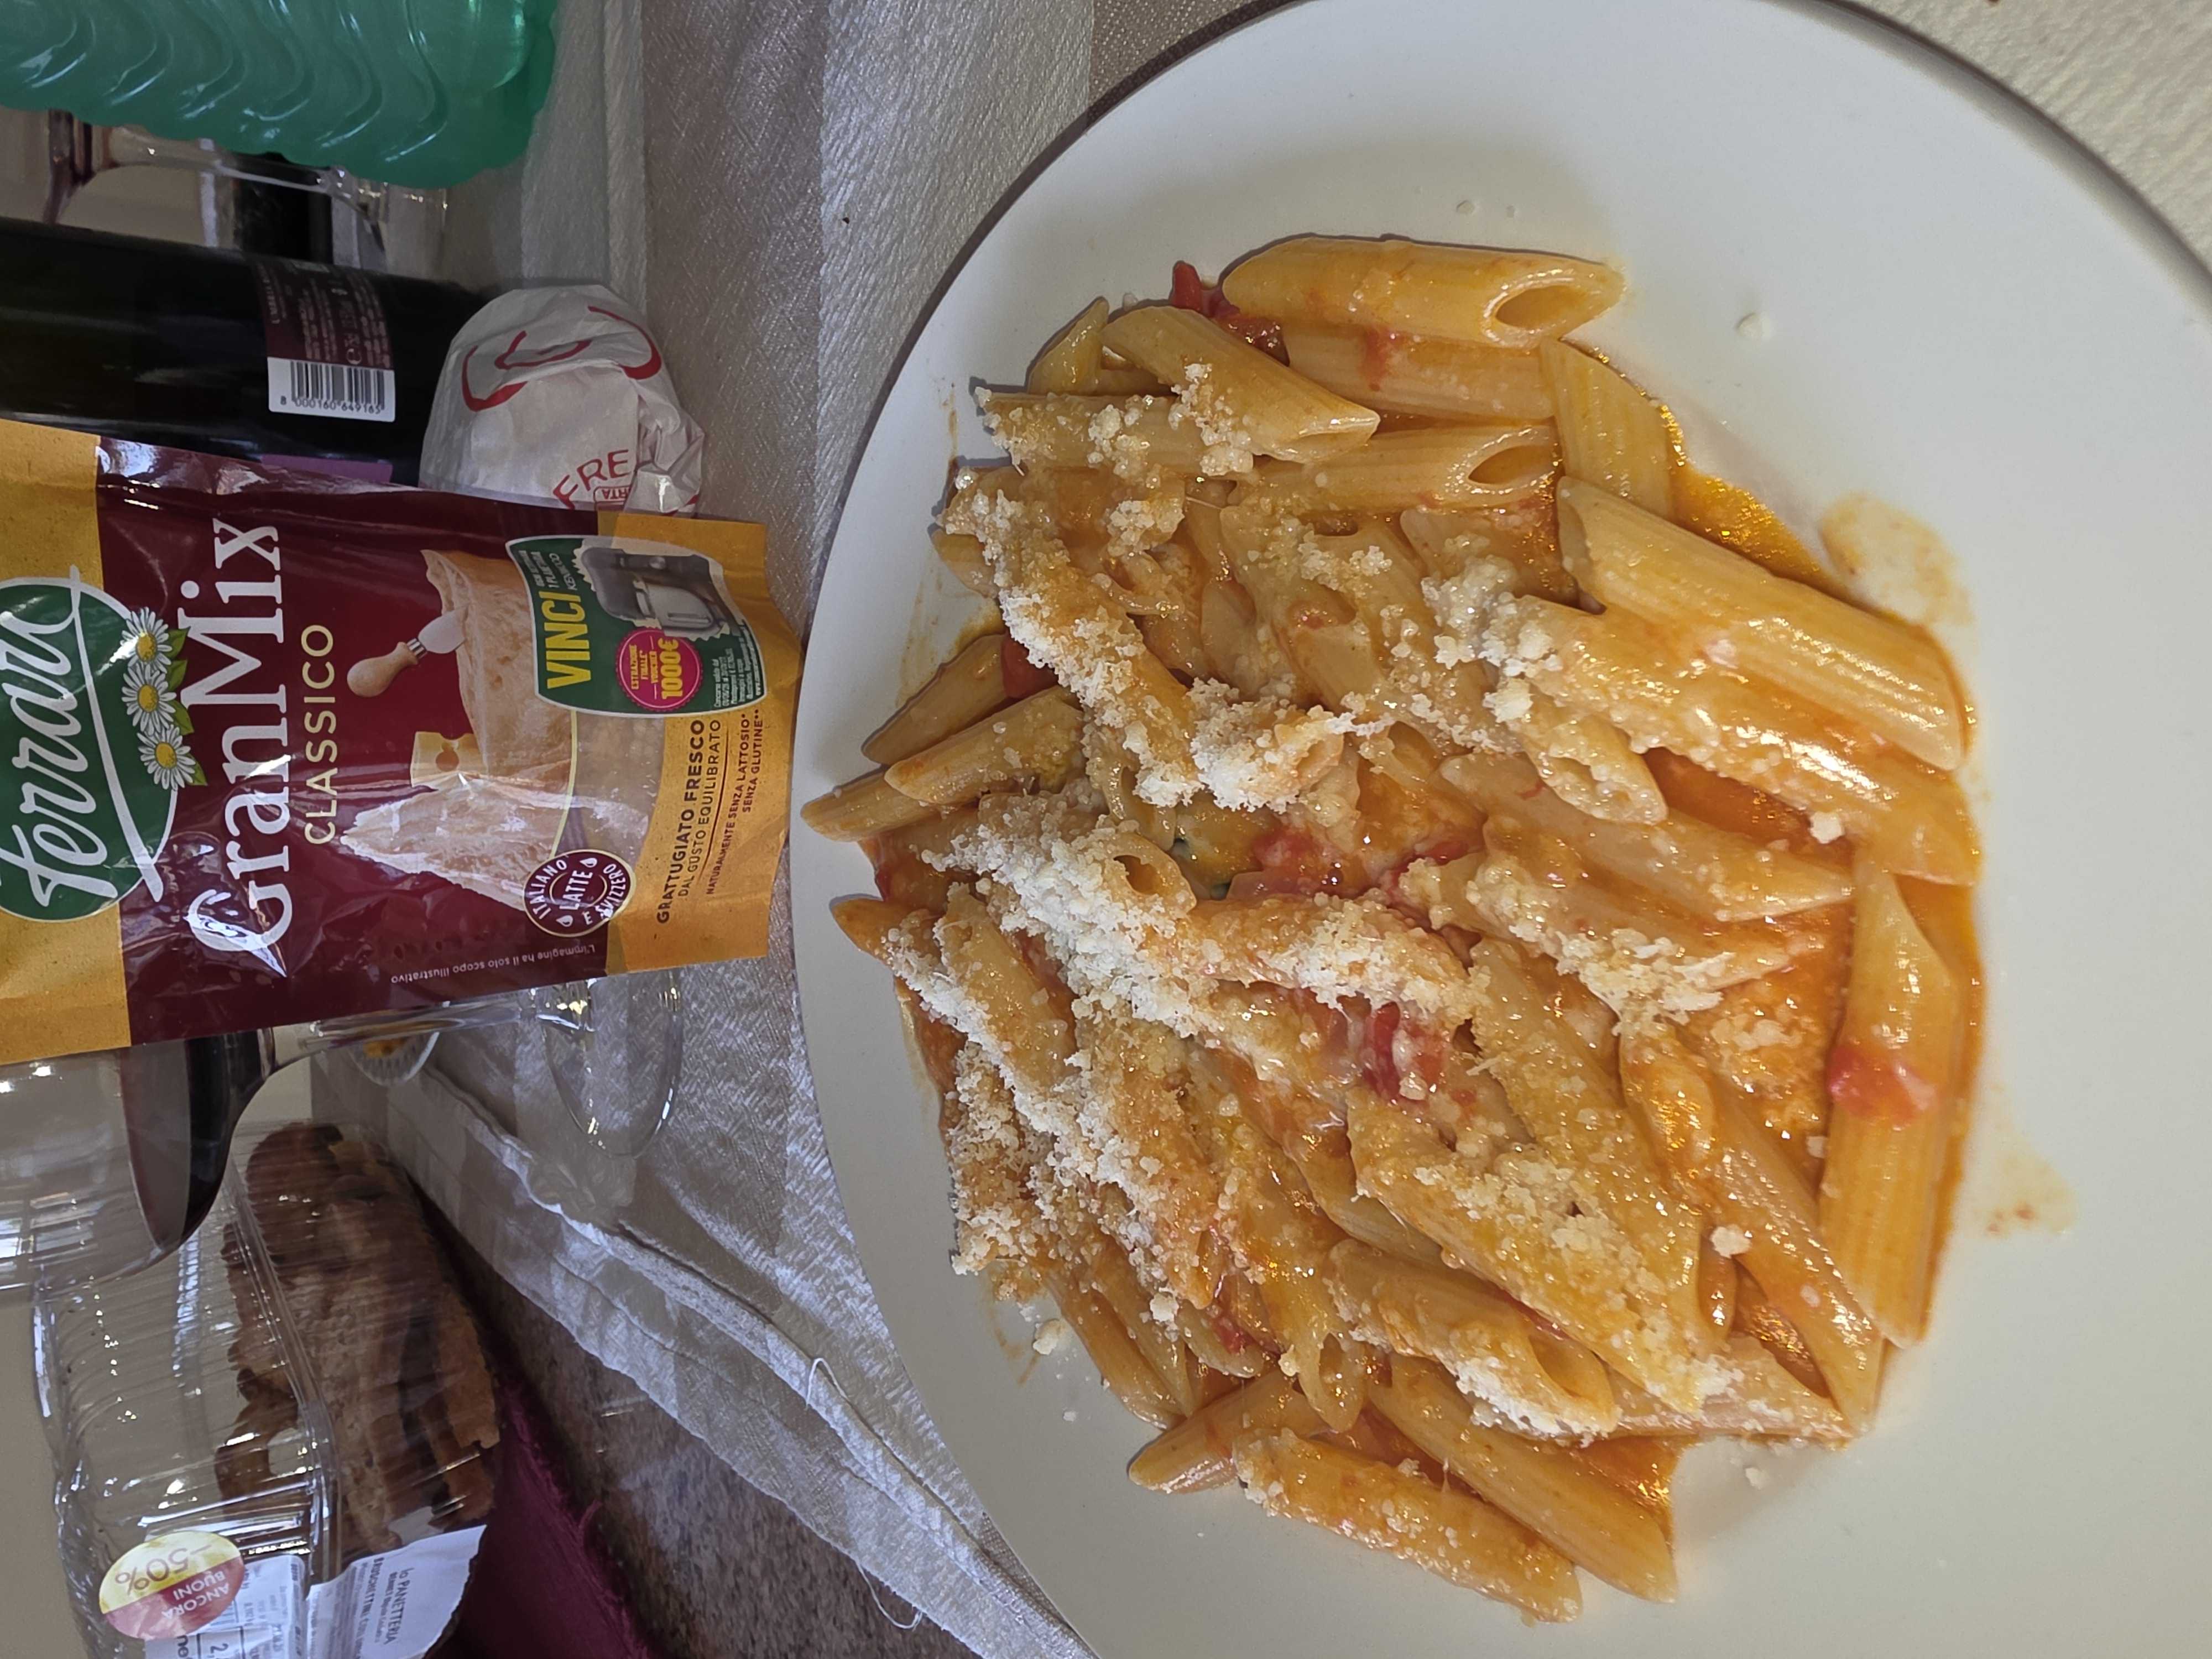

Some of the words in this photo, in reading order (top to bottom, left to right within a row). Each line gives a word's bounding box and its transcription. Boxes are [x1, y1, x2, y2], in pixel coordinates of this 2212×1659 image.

[280, 395, 286, 405] 8
[539, 591, 592, 688] VINCI
[658, 638, 683, 700] 1000€
[177, 518, 294, 952] GranMix
[301, 624, 338, 845] CLASSICO
[696, 719, 721, 825] EQUILIBRATO
[742, 777, 758, 813] SENZA
[656, 808, 695, 924] GRATTUGIATO
[684, 719, 705, 802] FRESCO
[705, 821, 735, 895] NATURALMENTE
[728, 785, 744, 819] SENZA
[687, 830, 707, 872] GUSTO
[529, 859, 568, 920] ITALIANO
[559, 870, 593, 910] LATTE
[678, 875, 696, 896] DAL
[452, 961, 486, 974] scopo
[488, 957, 510, 969] solo
[513, 955, 520, 966] il
[522, 953, 534, 964] ha
[537, 943, 595, 961] L'immagine
[390, 967, 450, 985] illustrativo
[160, 1583, 231, 1620] ANCORA
[173, 1571, 226, 1600] BUONI
